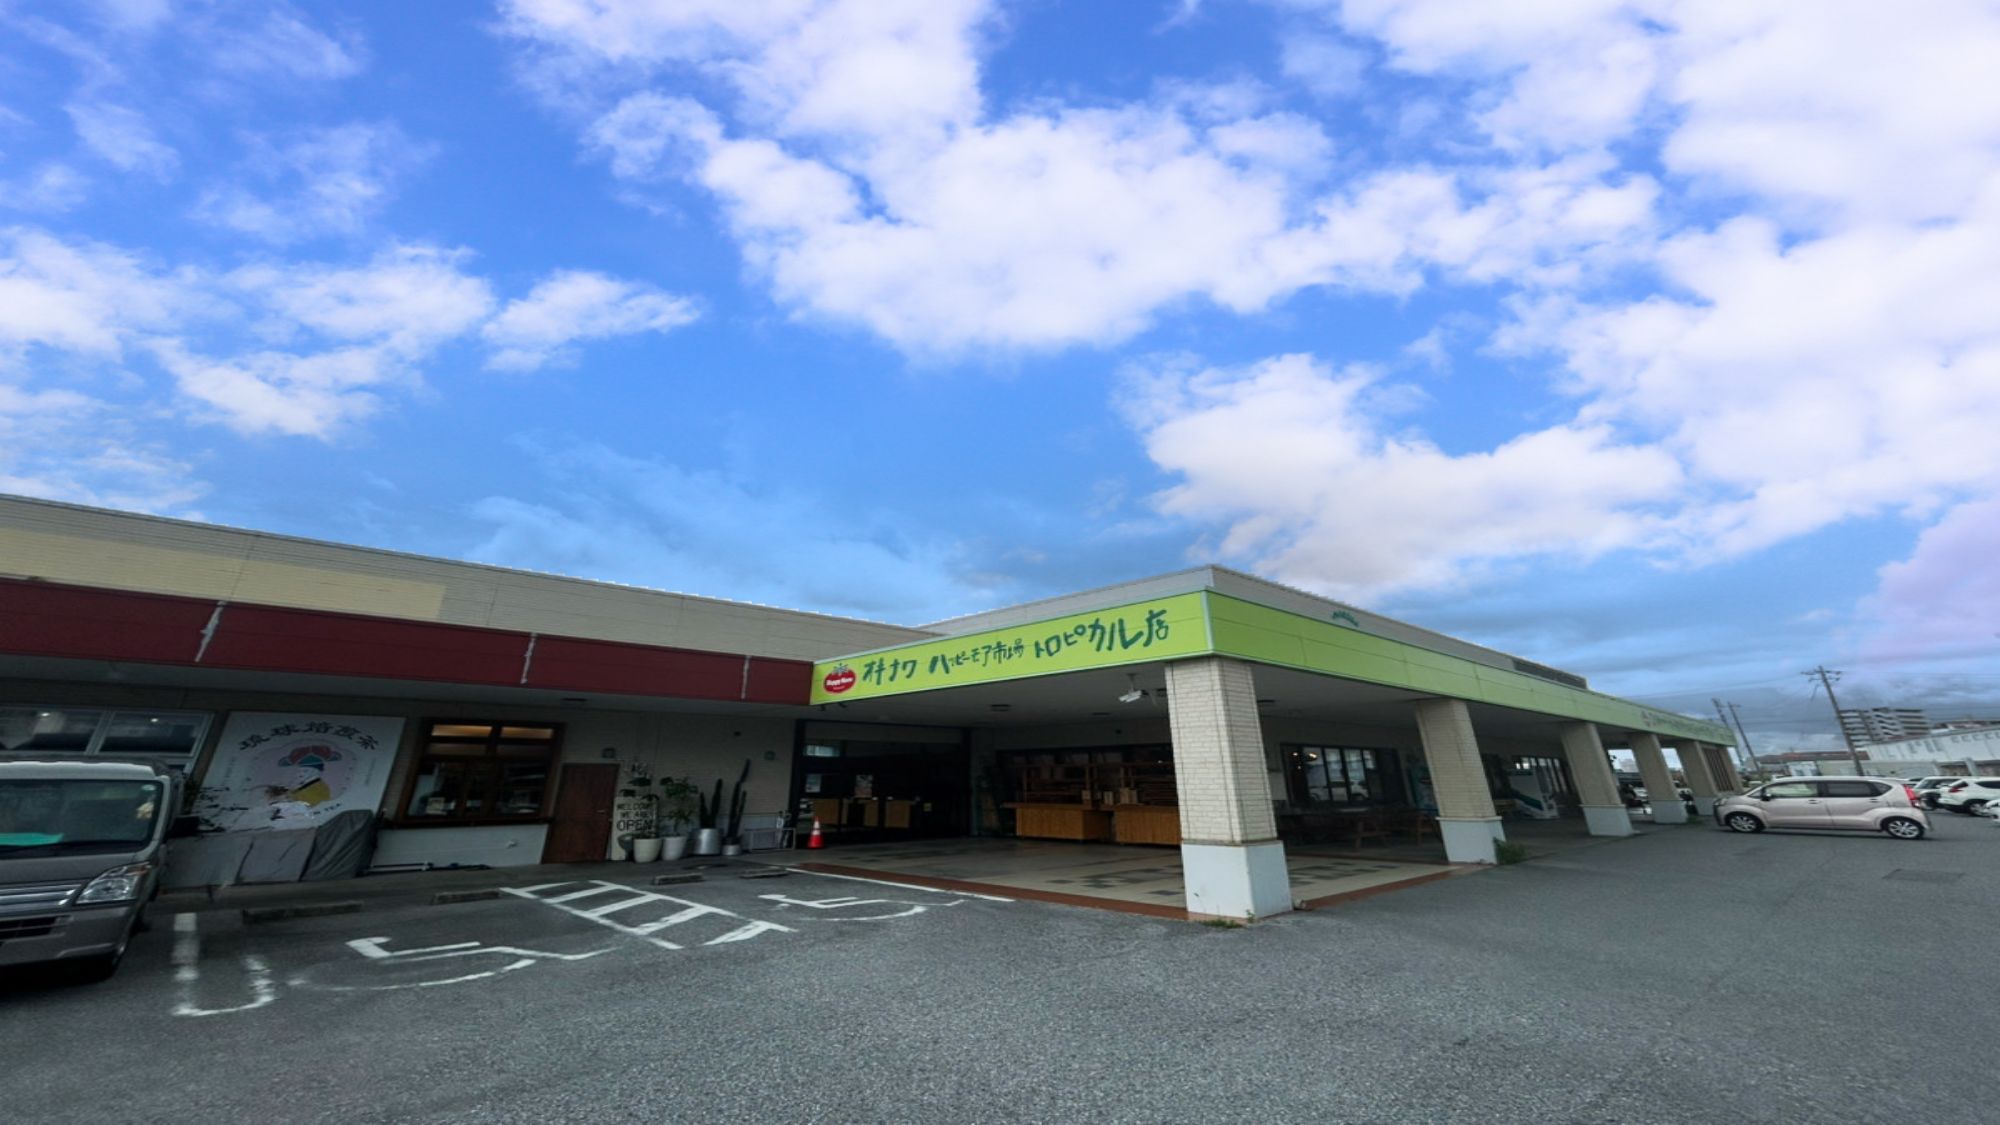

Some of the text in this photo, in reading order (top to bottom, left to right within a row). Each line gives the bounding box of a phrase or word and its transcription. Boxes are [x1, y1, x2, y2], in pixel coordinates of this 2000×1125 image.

[862, 609, 1169, 686] オキナワ ハッピーモア市場 トロピカル店
[616, 820, 653, 831] OPEN
